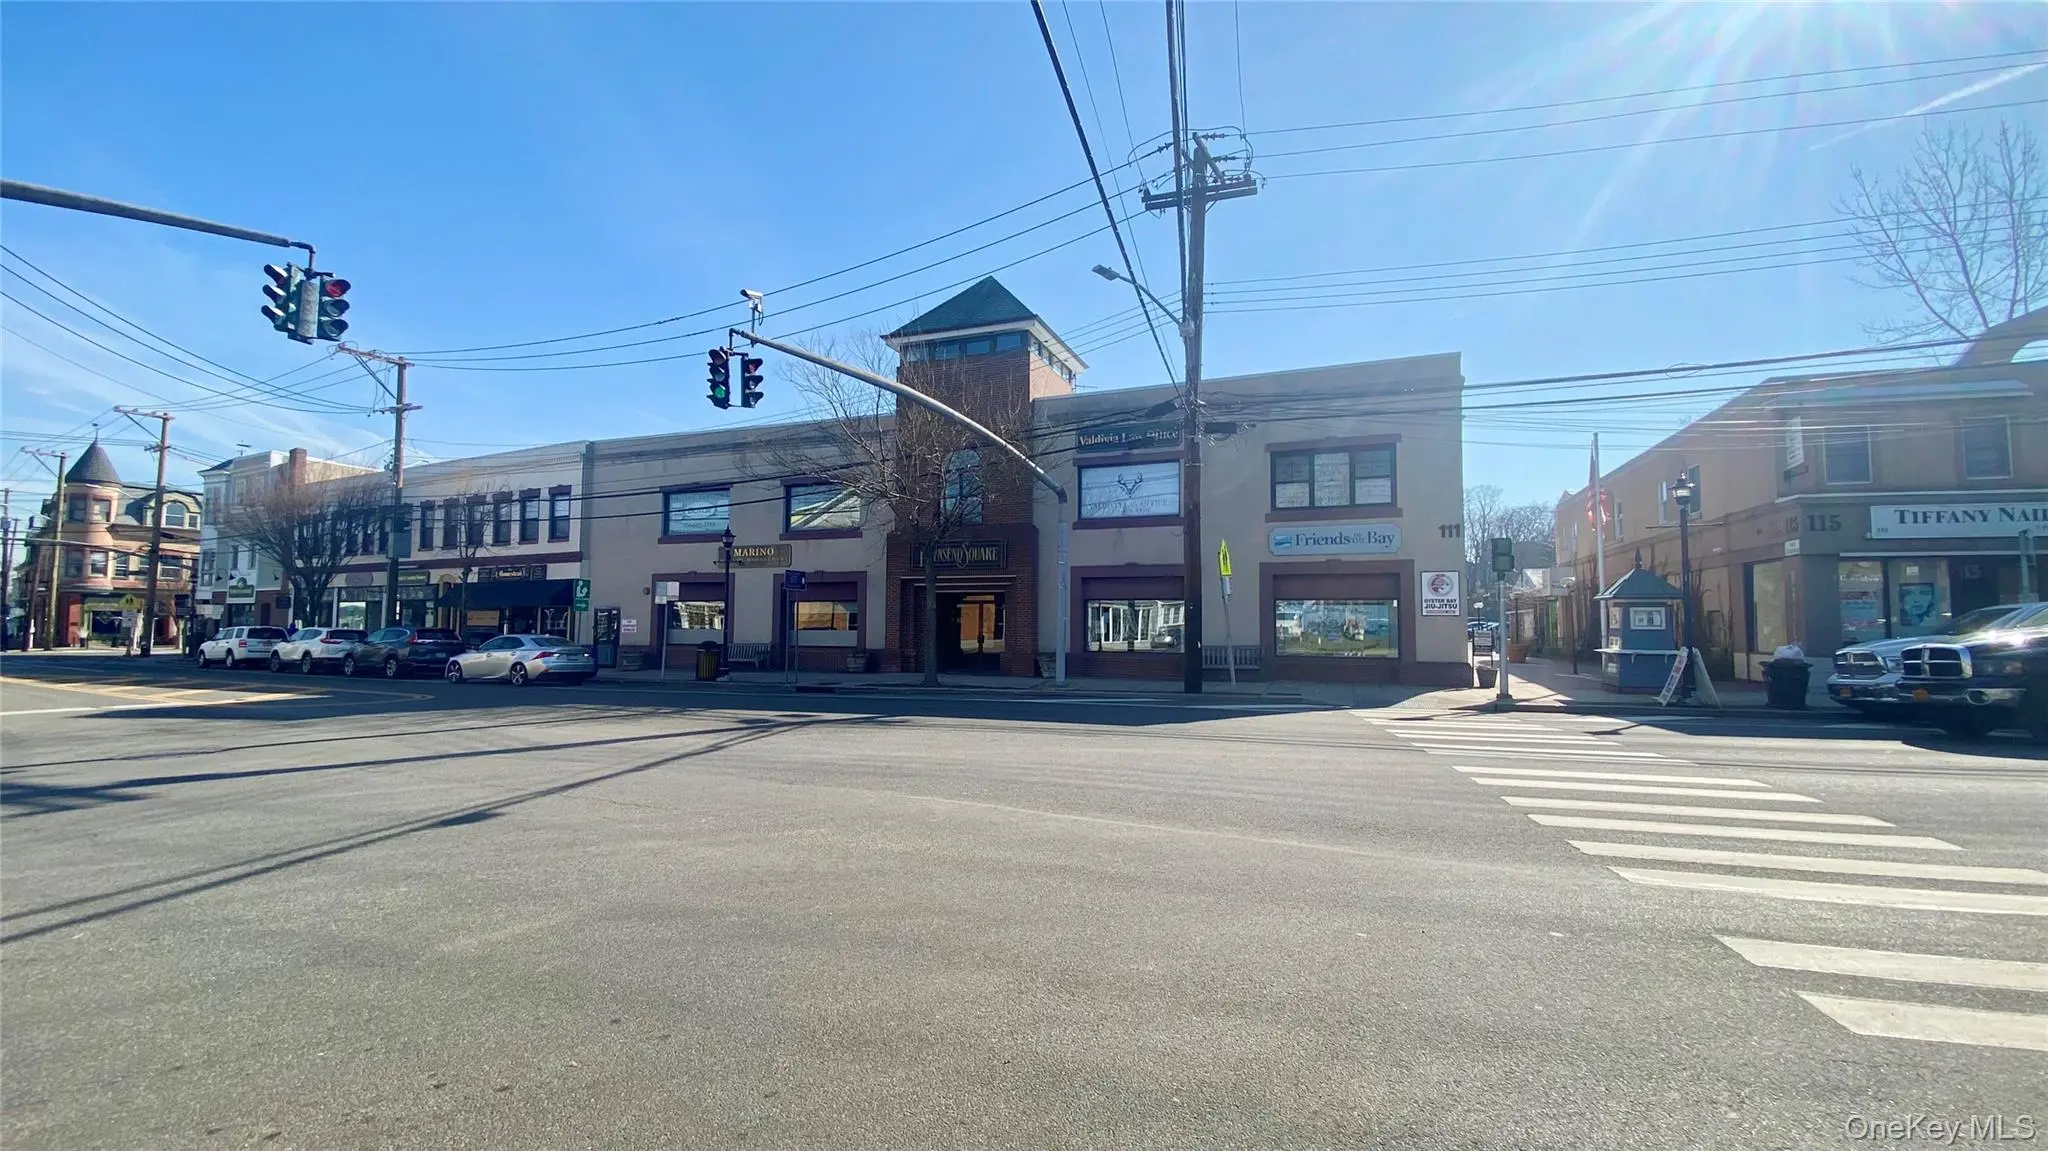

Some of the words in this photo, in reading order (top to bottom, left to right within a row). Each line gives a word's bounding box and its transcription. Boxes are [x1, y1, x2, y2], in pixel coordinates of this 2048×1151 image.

[1806, 514, 1841, 532] 115
[1894, 508, 1991, 525] TIFFANY
[1295, 532, 1351, 546] Friends
[1367, 531, 1395, 548] Bay
[1438, 524, 1460, 538] 111
[734, 547, 774, 557] MARINO
